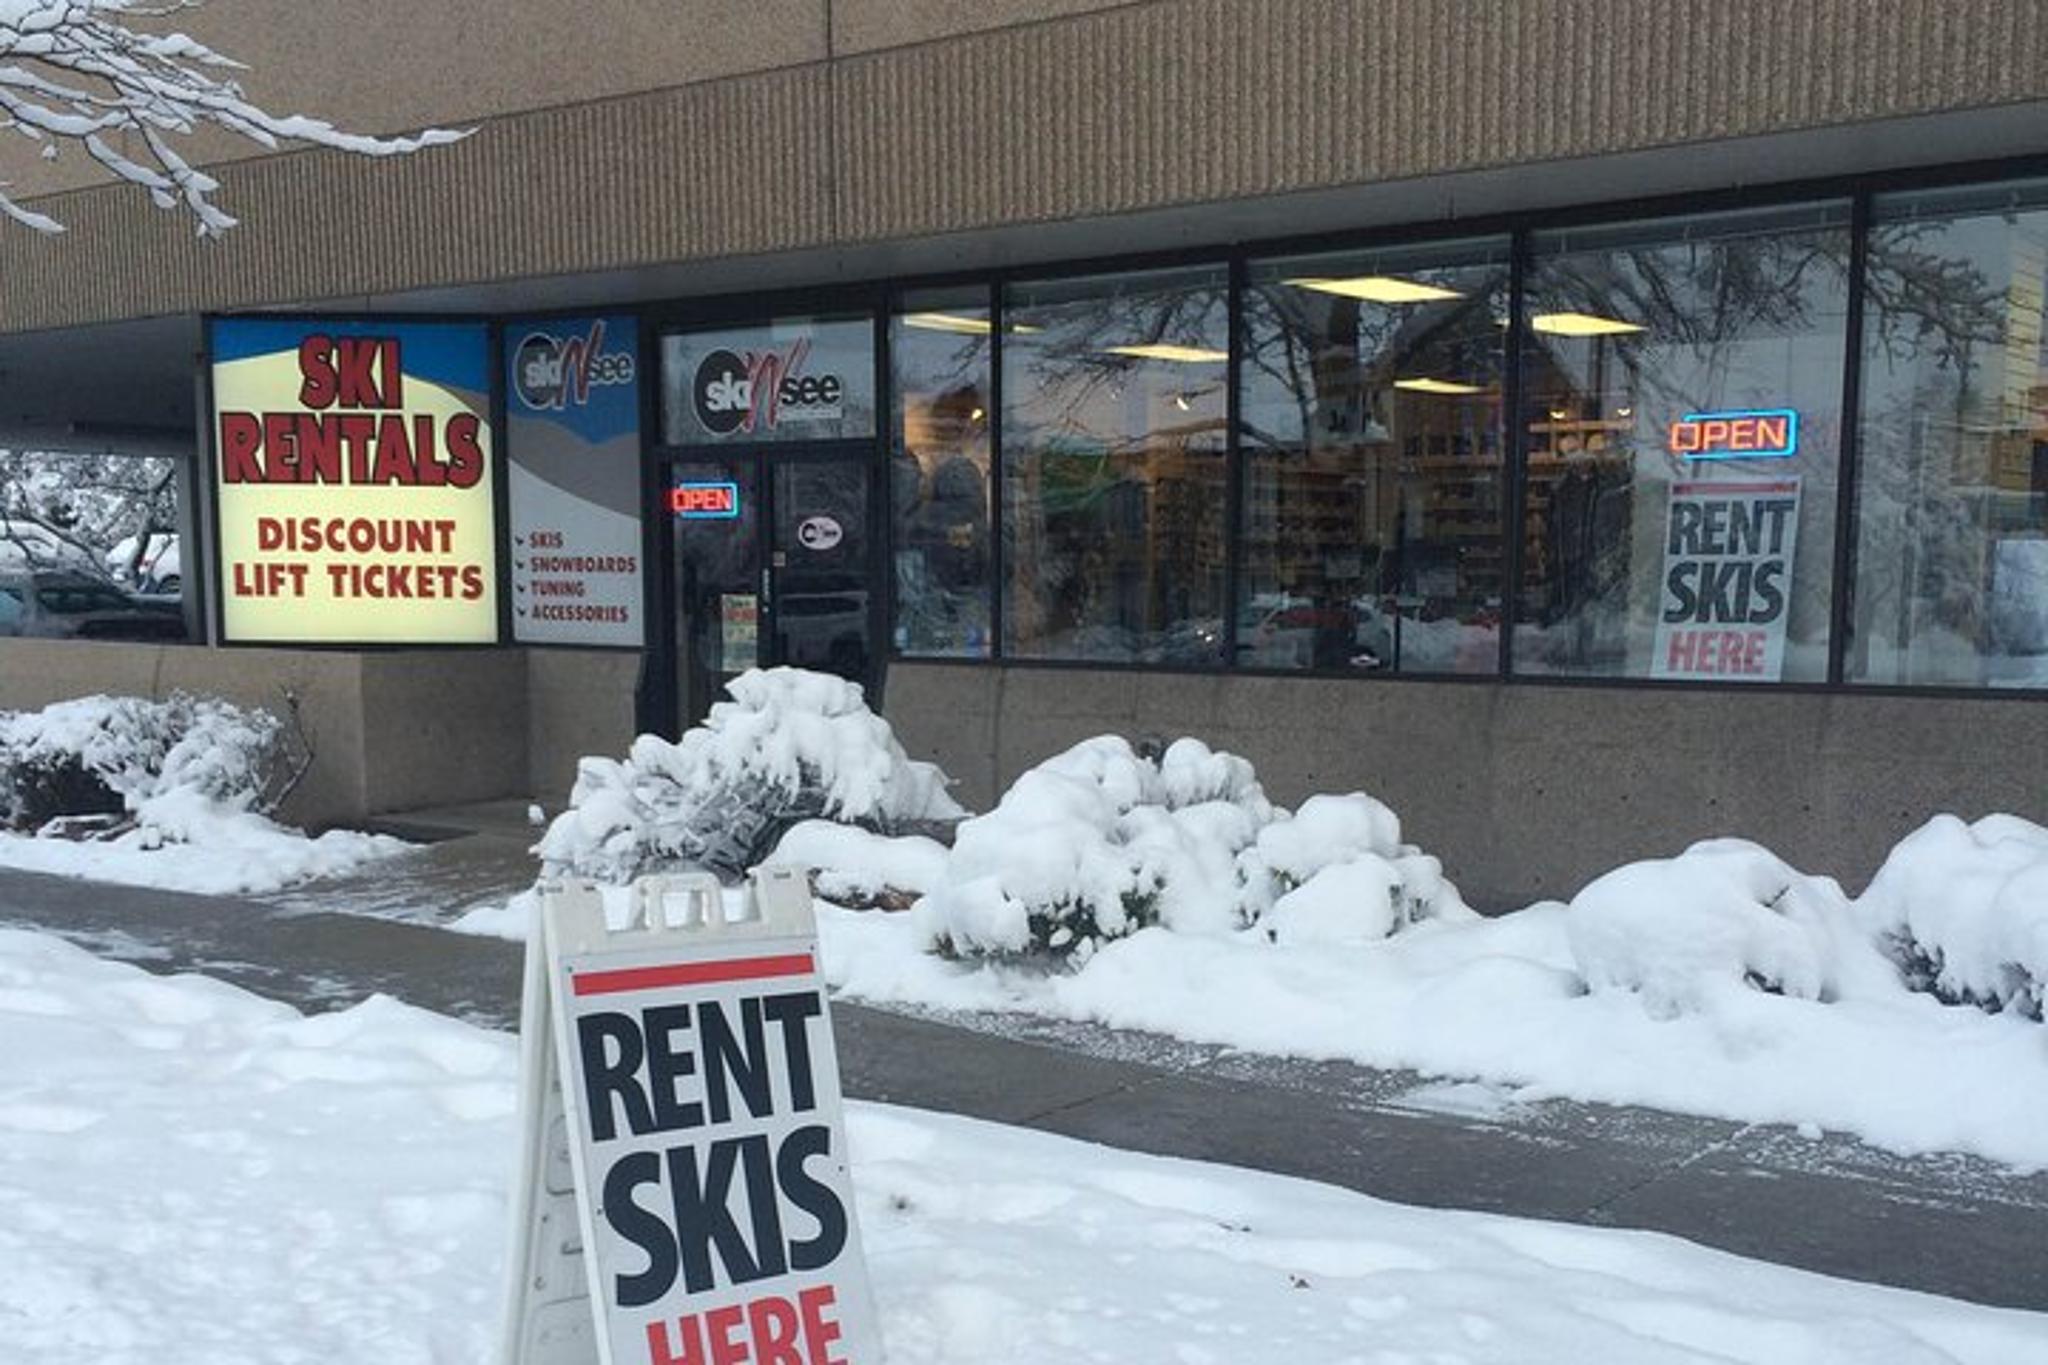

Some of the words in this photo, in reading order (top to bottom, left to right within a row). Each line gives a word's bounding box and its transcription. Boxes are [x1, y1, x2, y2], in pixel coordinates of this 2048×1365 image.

[298, 333, 403, 411] SKI
[220, 412, 485, 489] RENTALS
[1670, 419, 1786, 451] OPEN
[672, 488, 731, 511] OPEN
[258, 517, 455, 553] DISCOUNT
[529, 532, 563, 548] SKIS
[1669, 500, 1795, 555] RENT
[233, 564, 308, 597] LIFT
[327, 565, 484, 599] TICKETS
[531, 556, 636, 572] SNOWBOARDS
[531, 580, 586, 596] TUNING
[1664, 560, 1784, 624] SKIS
[532, 604, 629, 622] ACCESSORIES
[1667, 631, 1767, 675] HERE
[577, 991, 821, 1142] RENT
[602, 1126, 848, 1307] SKIS
